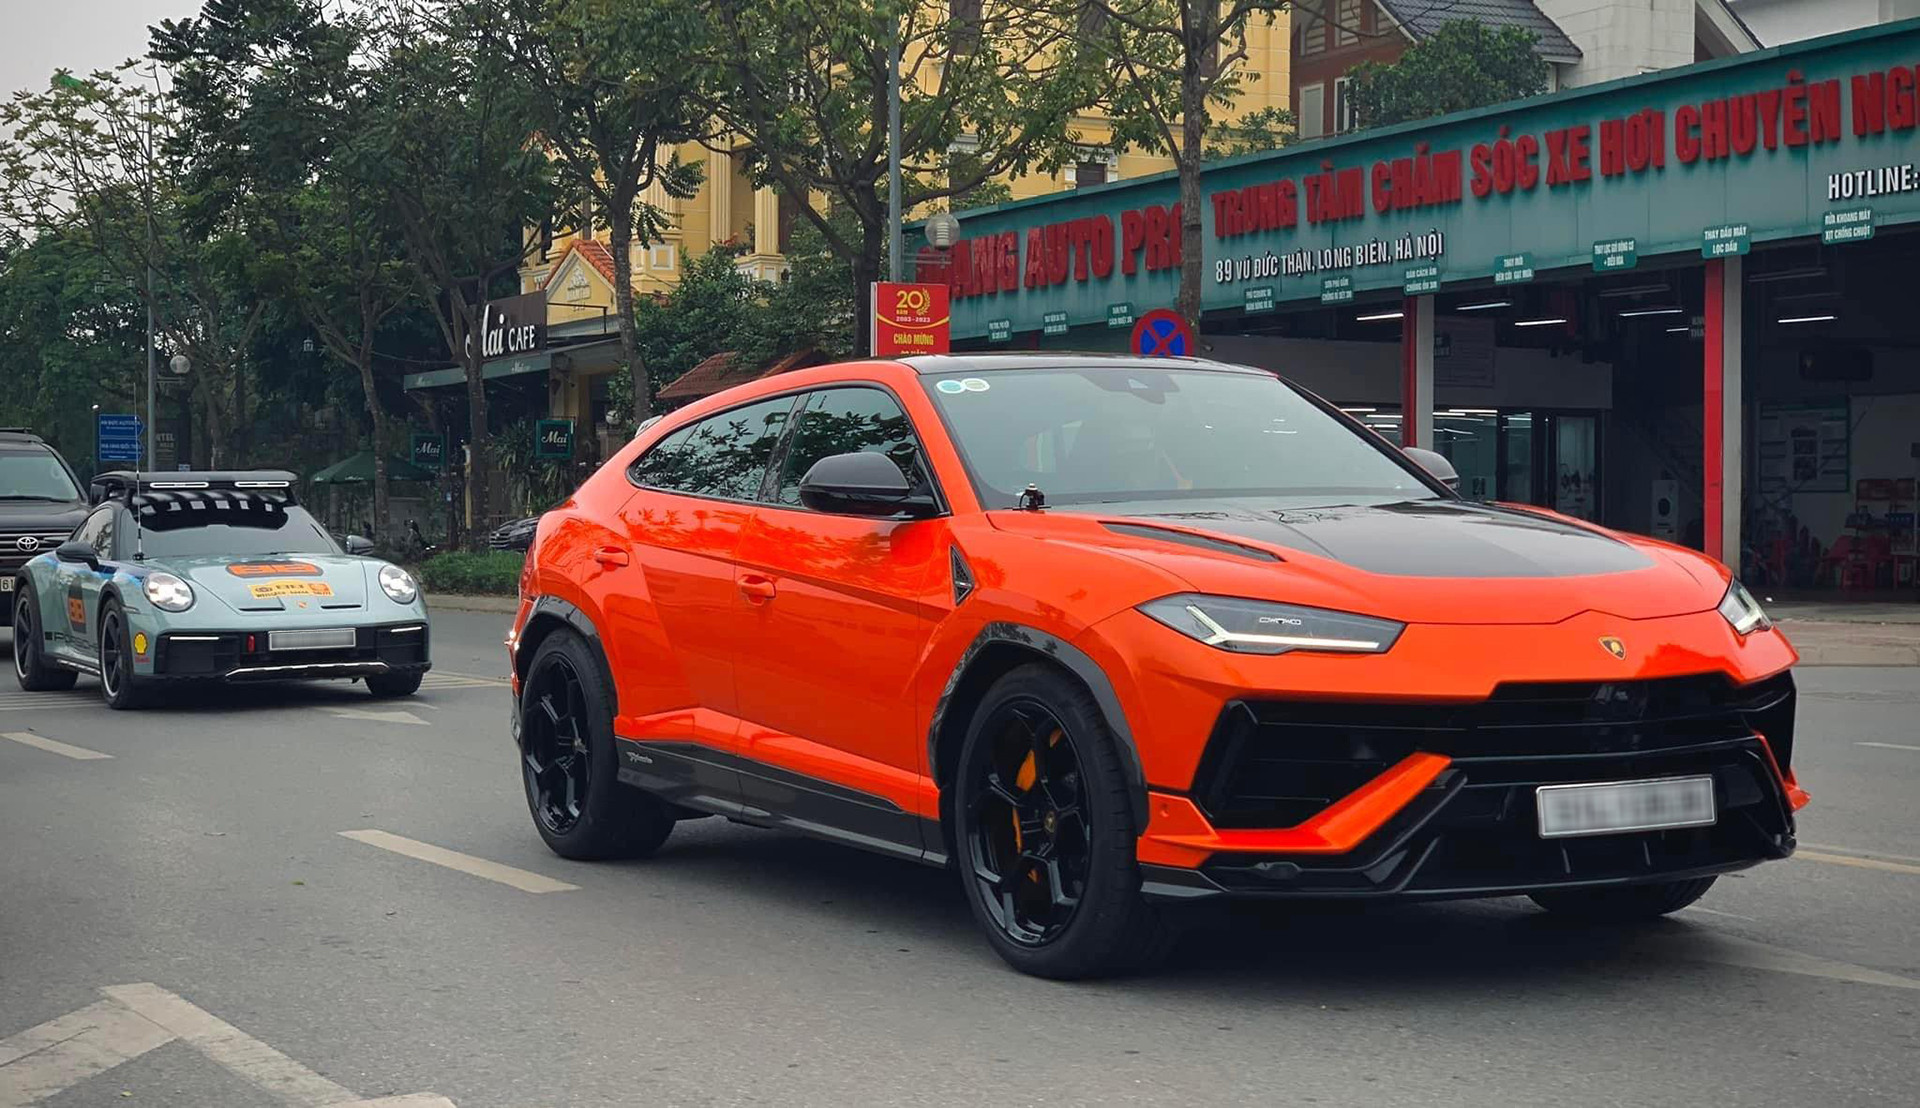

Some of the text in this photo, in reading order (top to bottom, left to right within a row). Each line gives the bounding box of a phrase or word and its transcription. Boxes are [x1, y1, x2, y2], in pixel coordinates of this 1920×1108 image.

[1211, 178, 1297, 238] TRUNG
[1303, 158, 1364, 224] TÂM
[1469, 125, 1538, 197] SÓC
[1545, 124, 1591, 185] XE
[1600, 107, 1666, 176] HƠI
[1675, 69, 1841, 164] CHUYÊN
[1850, 63, 1920, 136] NG
[1828, 163, 1920, 201] HOTLINE:
[1024, 214, 1115, 289] AUTO
[1215, 258, 1233, 283] 89
[1254, 249, 1279, 279] ĐỨC
[1318, 246, 1352, 270] LONG
[1395, 231, 1413, 260] HÀ
[1417, 228, 1443, 262] NỘI
[896, 290, 924, 309] 20
[508, 325, 536, 352] CAFE
[893, 331, 913, 345] CHÀO
[415, 442, 441, 454] Mai
[541, 431, 568, 444] Mai
